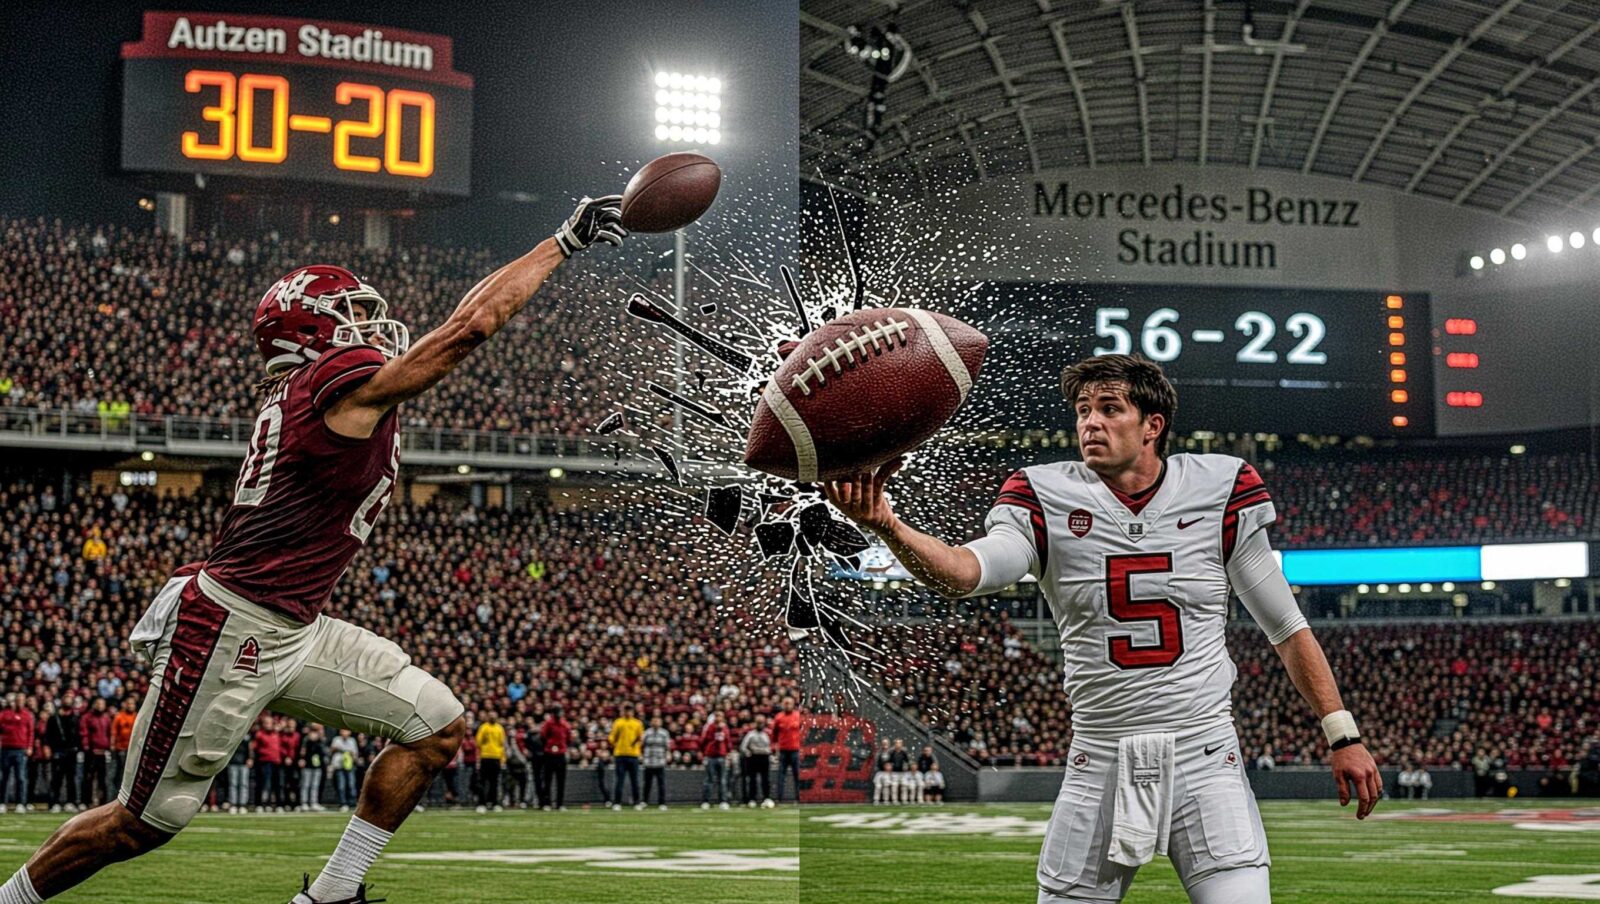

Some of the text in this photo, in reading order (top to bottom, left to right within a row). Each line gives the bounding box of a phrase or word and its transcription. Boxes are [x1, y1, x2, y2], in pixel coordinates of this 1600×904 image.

[168, 17, 433, 70] Autzen Stadium
[181, 69, 435, 178] 30-20
[1033, 182, 1360, 228] Mercedes-Benzz
[1117, 228, 1277, 269] Stadium
[1093, 307, 1328, 365] 56-22
[1104, 551, 1185, 670] 5
